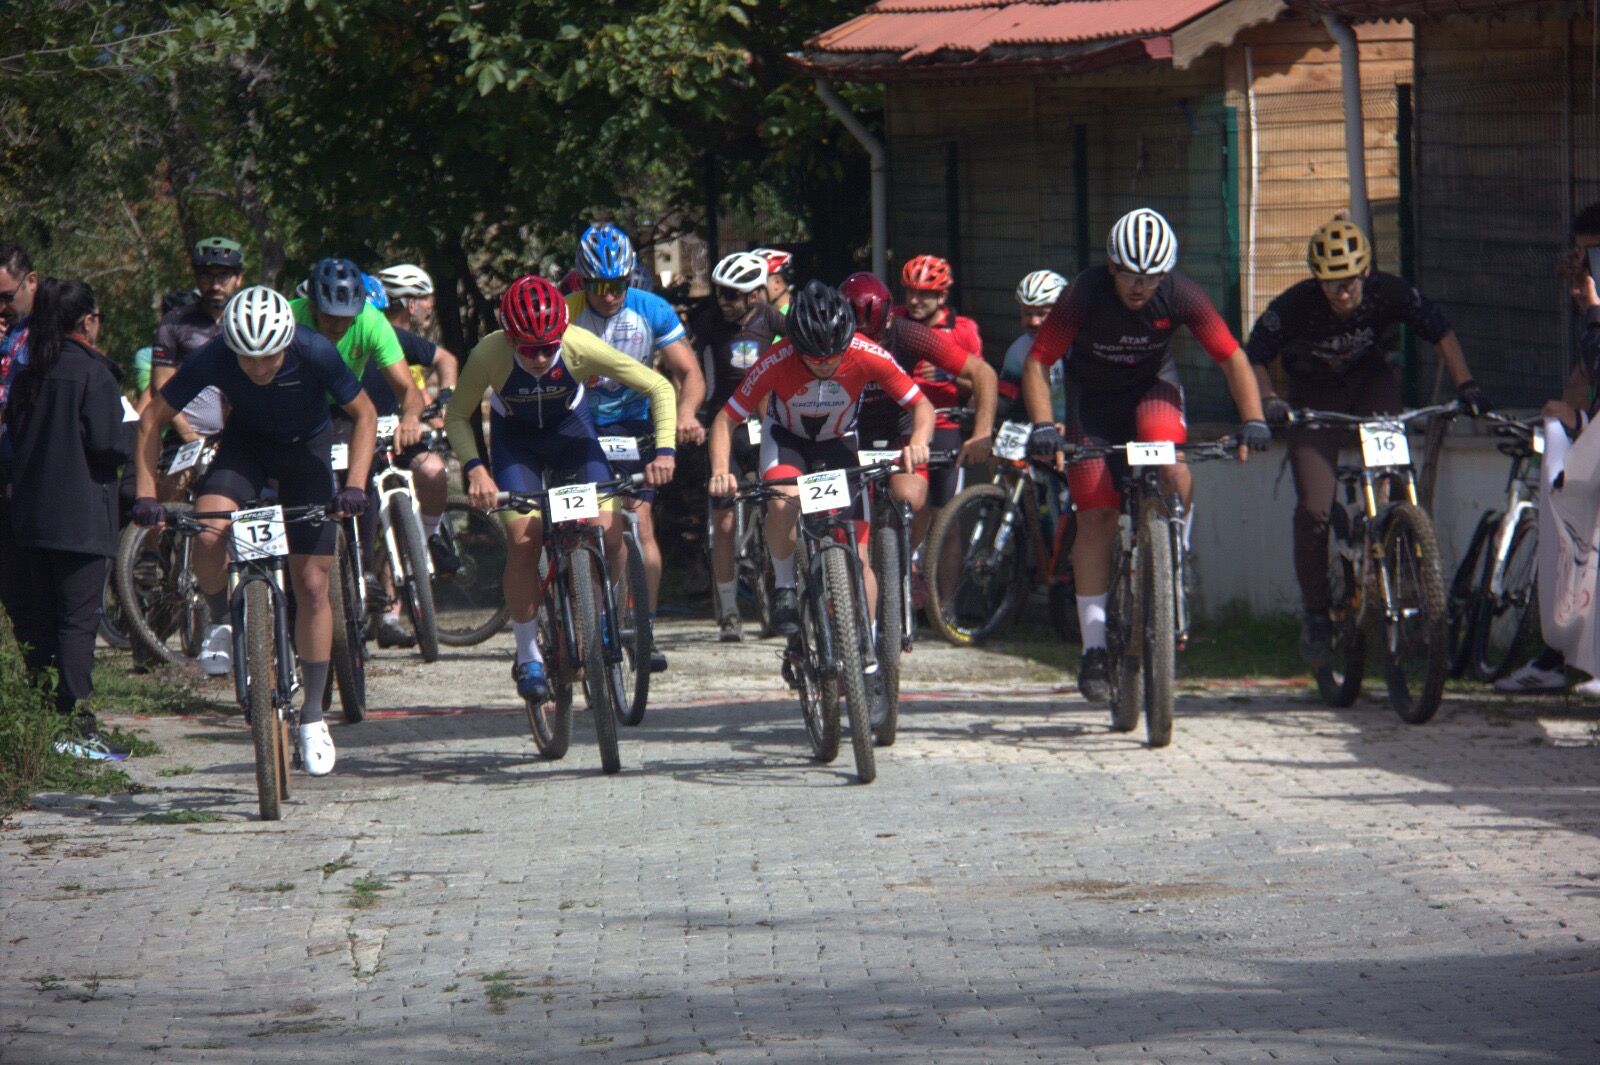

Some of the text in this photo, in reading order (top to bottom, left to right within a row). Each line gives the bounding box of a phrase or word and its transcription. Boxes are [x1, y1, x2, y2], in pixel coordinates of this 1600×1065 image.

[849, 337, 907, 376] ERZU
[740, 344, 794, 397] ERZURUM
[607, 444, 627, 453] 15
[1373, 436, 1396, 451] 16
[809, 483, 839, 500] 24
[562, 496, 585, 509] 12
[246, 523, 272, 543] 13
